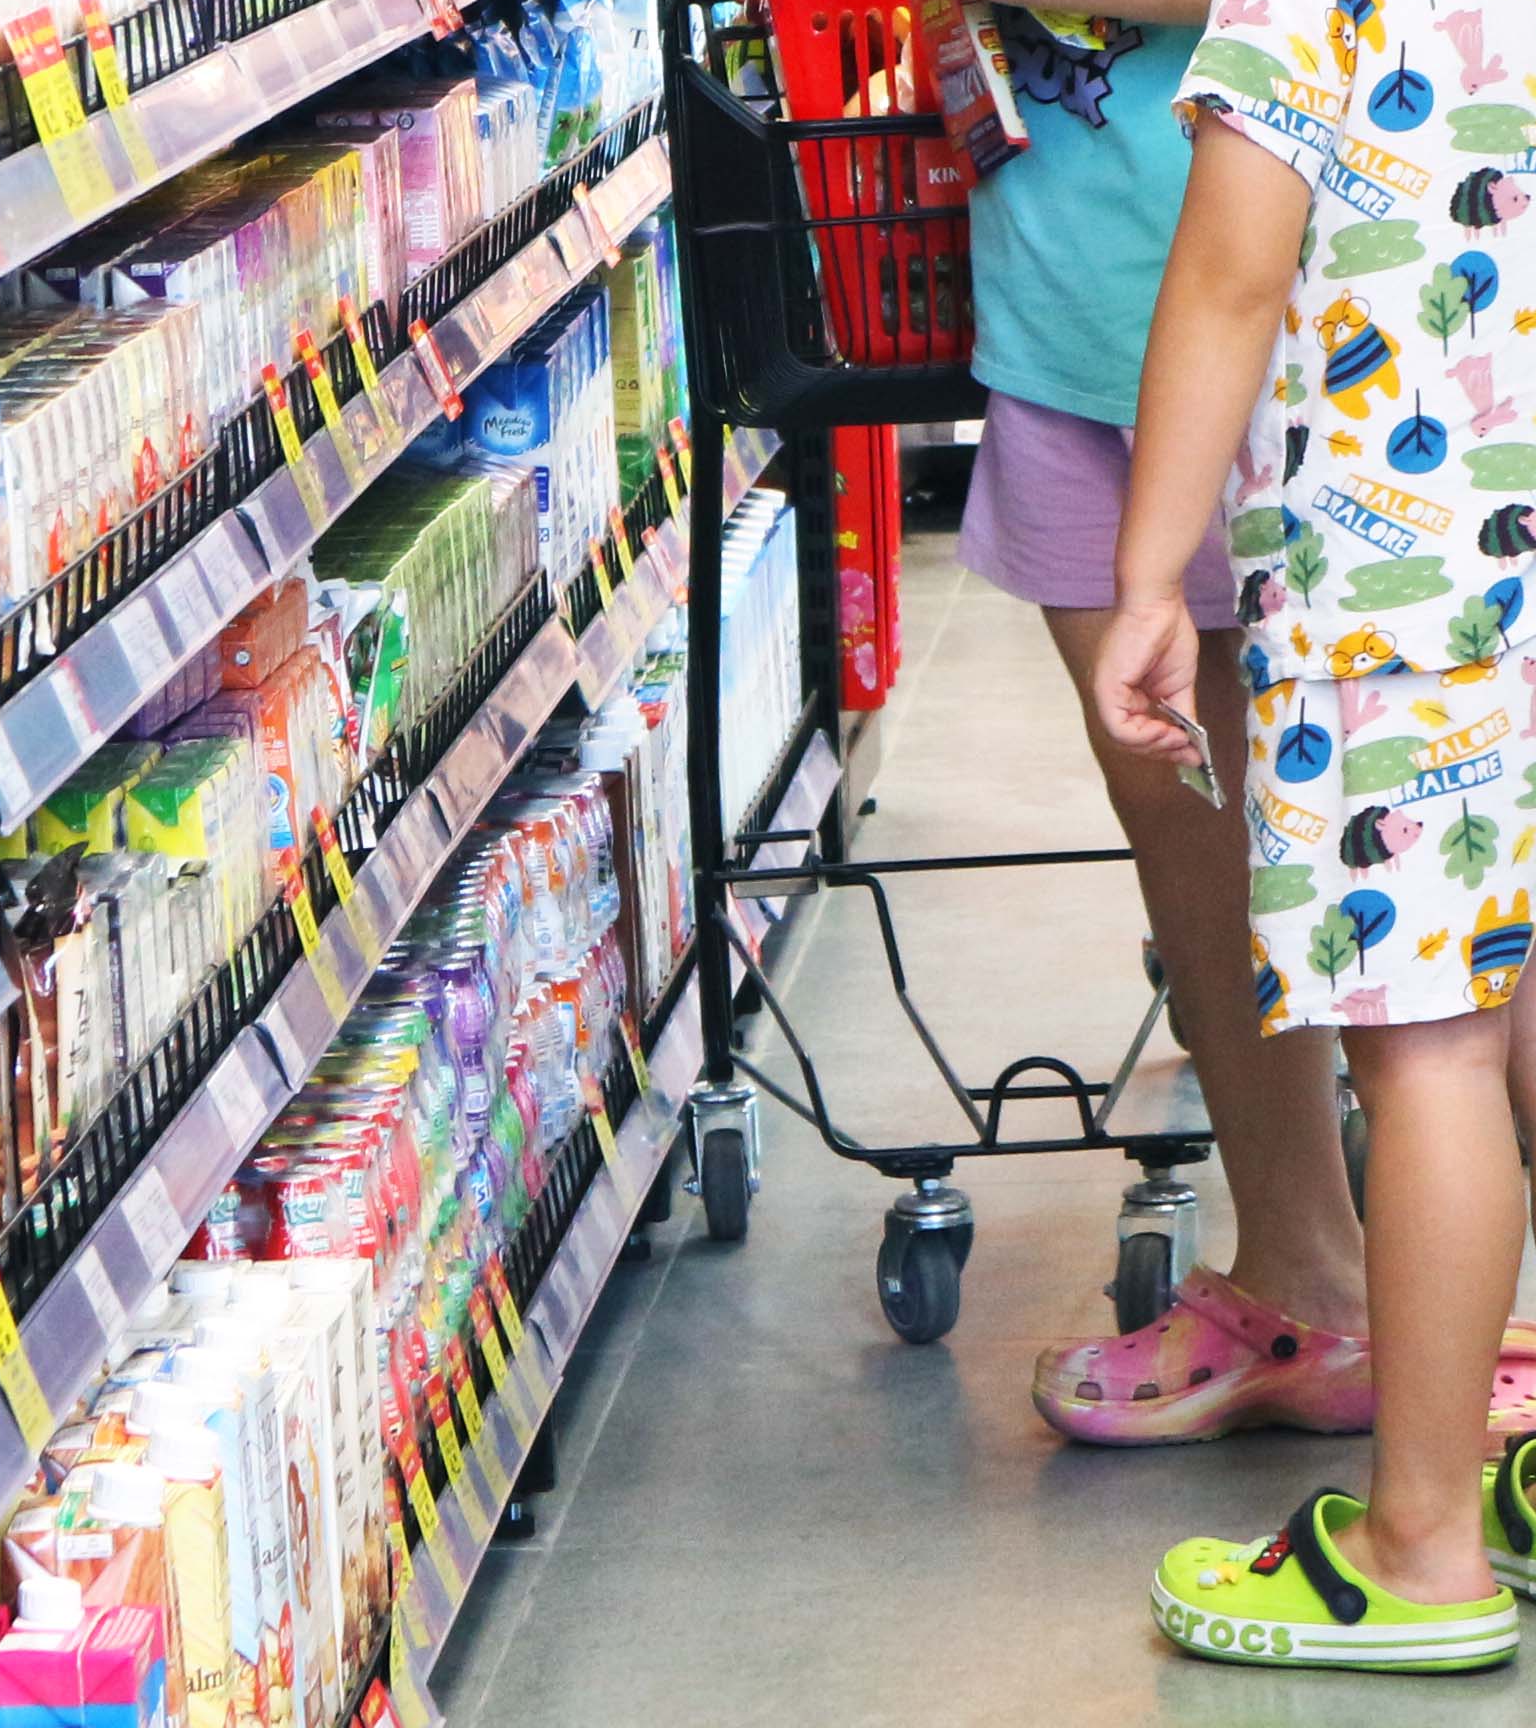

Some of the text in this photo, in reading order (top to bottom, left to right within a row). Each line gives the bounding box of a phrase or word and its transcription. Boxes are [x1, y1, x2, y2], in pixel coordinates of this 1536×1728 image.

[1312, 485, 1418, 558] BRALORE
[1340, 474, 1455, 536] BRALORE
[1163, 1604, 1293, 1657] crocs
